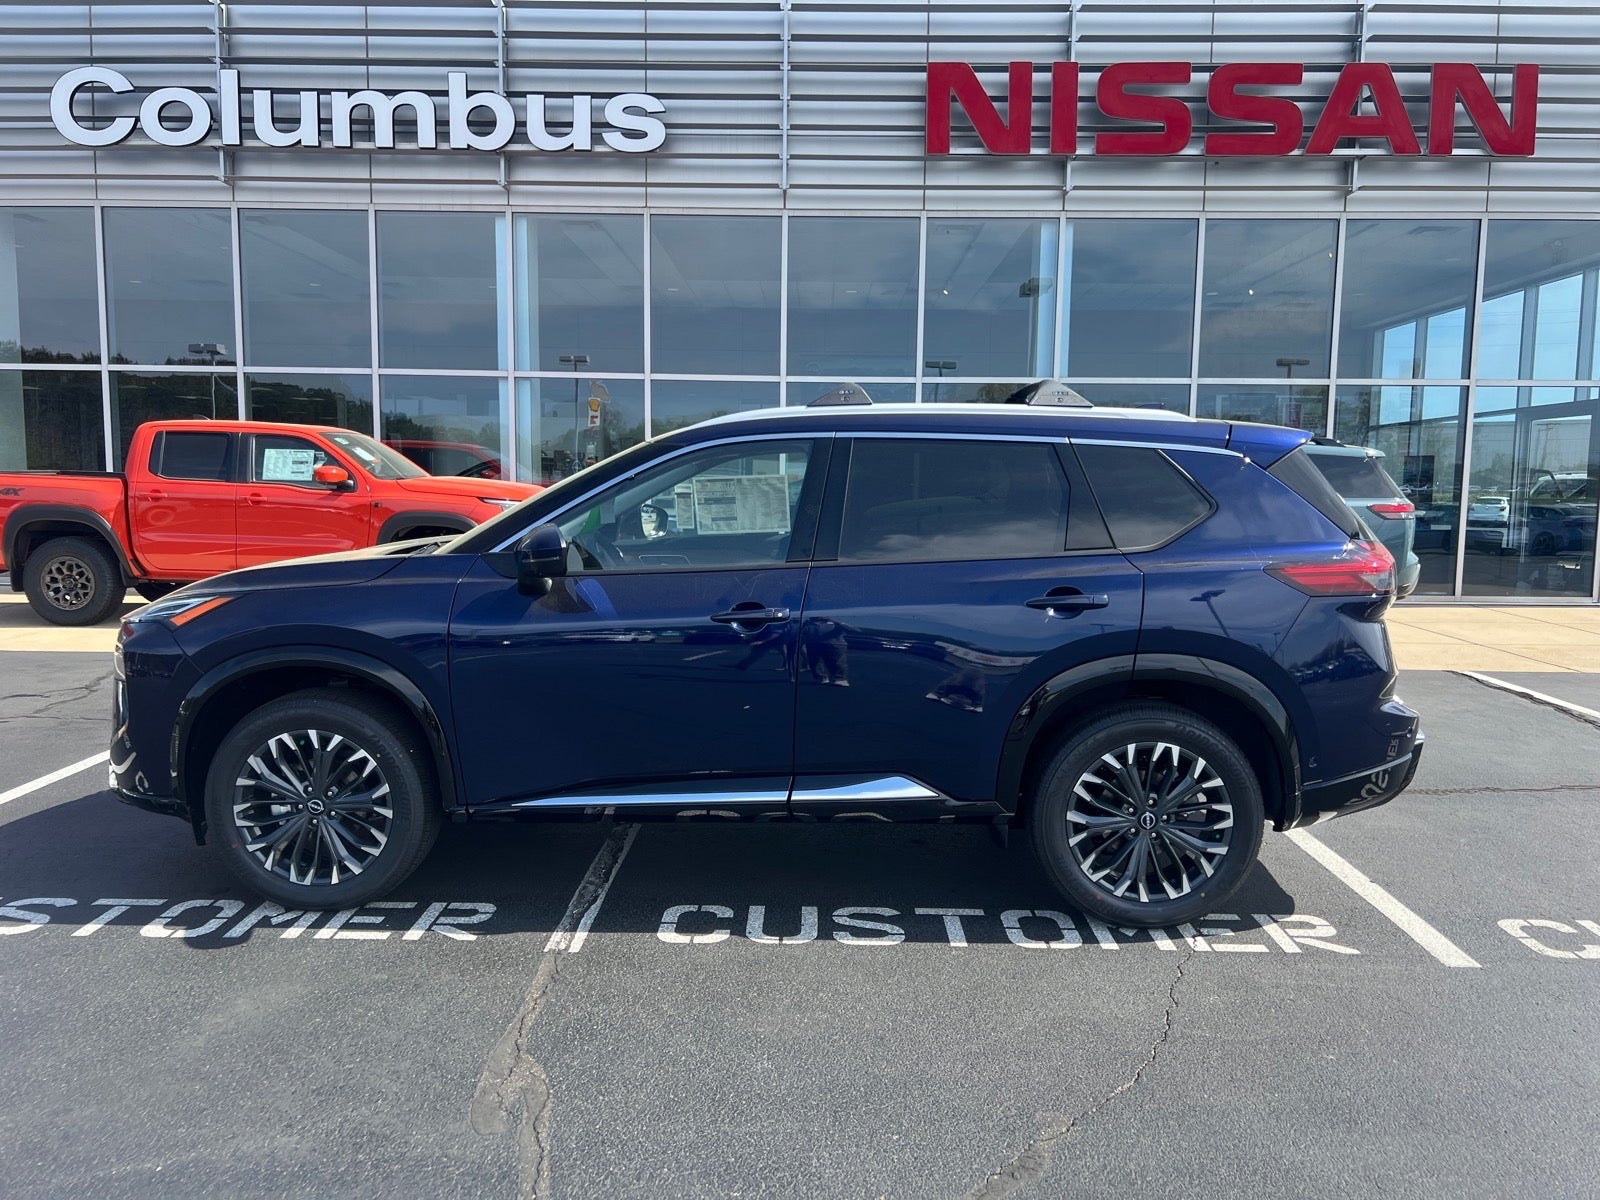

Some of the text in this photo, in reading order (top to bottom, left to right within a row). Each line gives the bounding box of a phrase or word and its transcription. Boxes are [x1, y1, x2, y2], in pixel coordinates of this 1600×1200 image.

[49, 65, 668, 154] Columbus
[925, 61, 1540, 158] NISSAN
[0, 897, 497, 940] STOMER
[656, 903, 1361, 955] CUSTOMER
